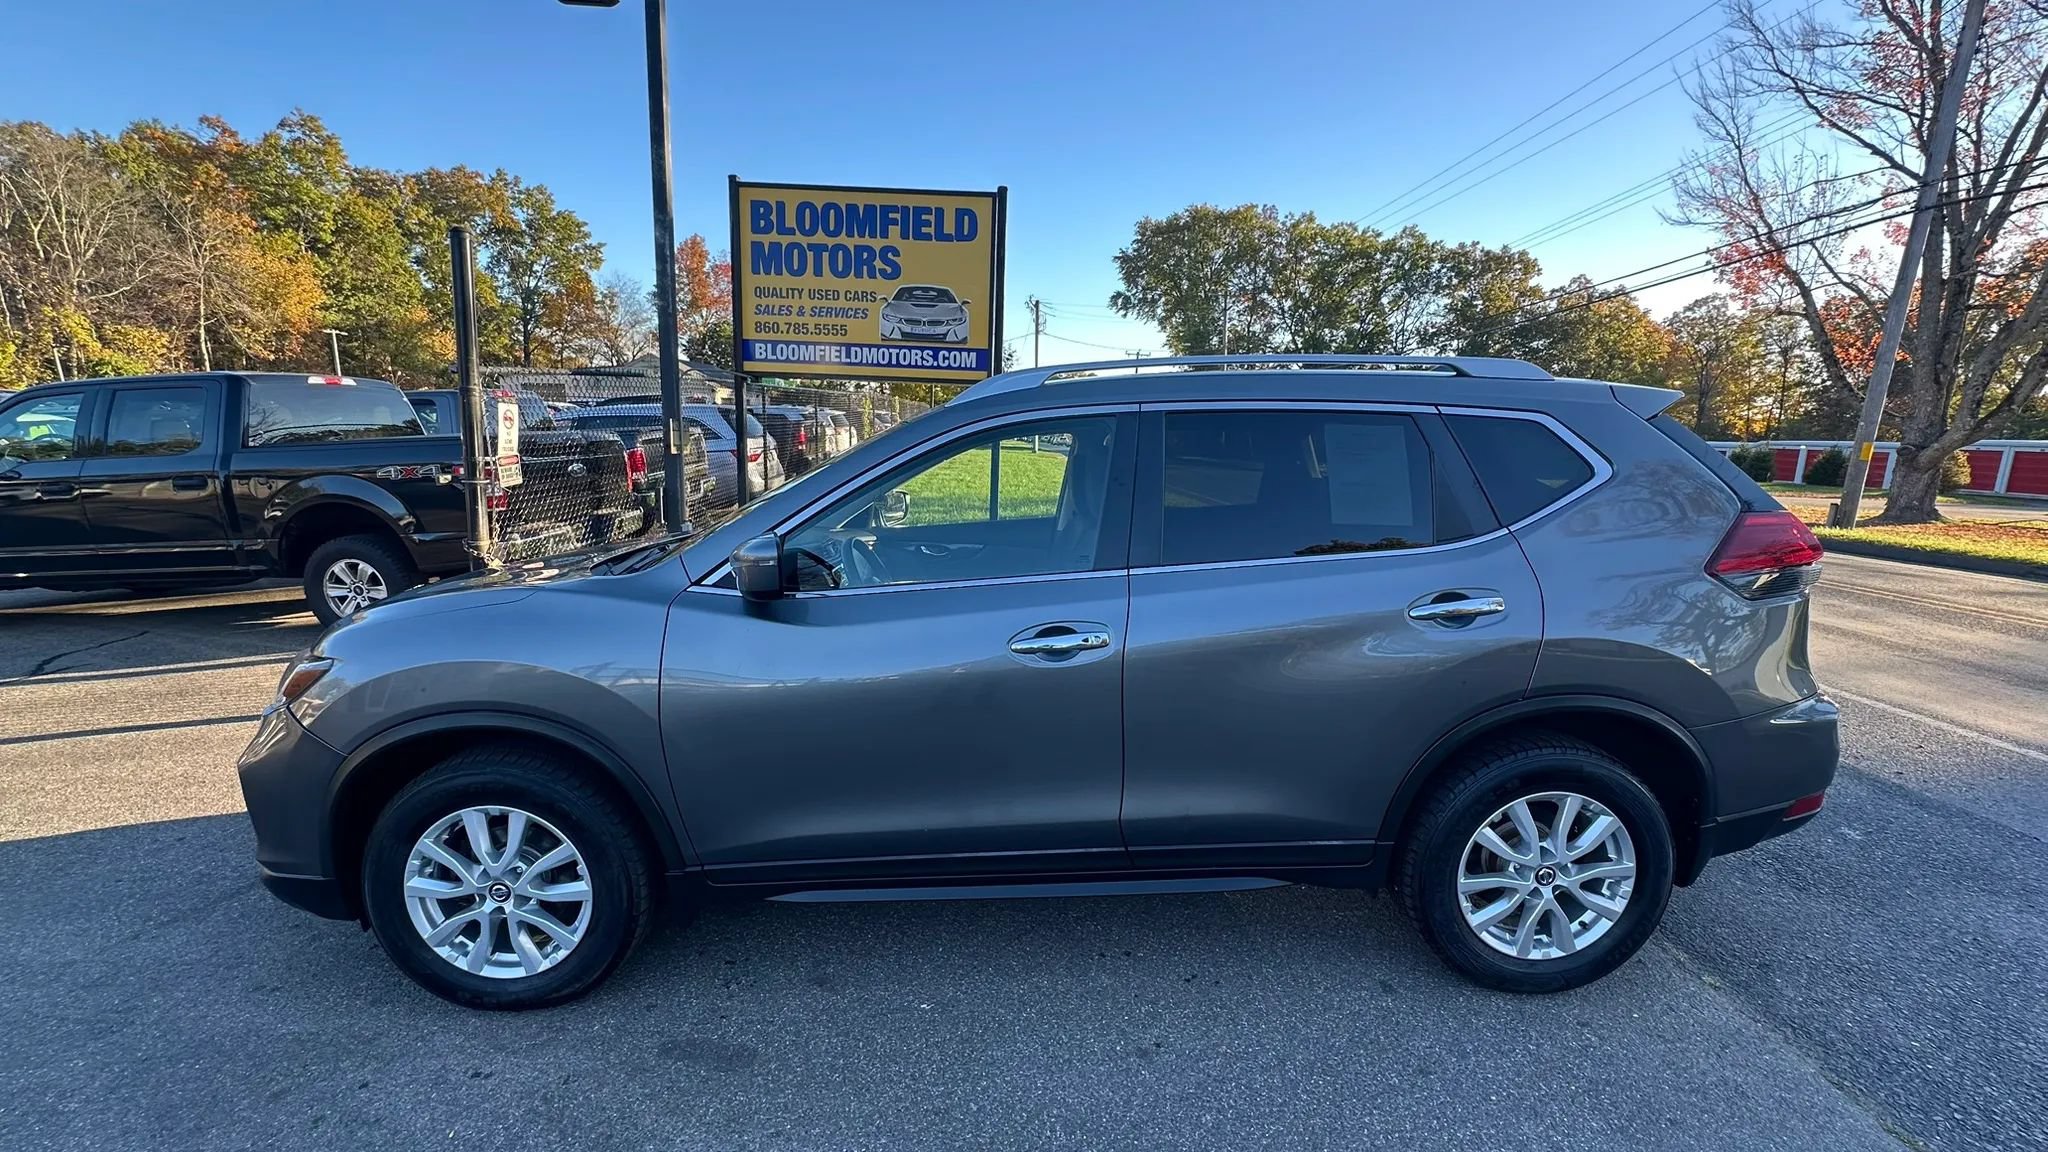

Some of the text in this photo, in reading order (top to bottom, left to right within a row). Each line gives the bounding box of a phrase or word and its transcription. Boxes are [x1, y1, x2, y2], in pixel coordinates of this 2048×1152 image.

[750, 199, 979, 243] BLOOMFIELD
[750, 240, 902, 280] MOTORS
[754, 286, 877, 303] QUALITY USED CARS
[754, 304, 869, 320] SALES & SERVICES
[754, 321, 848, 337] 860.785.5555
[754, 342, 977, 368] BLOOMFIELDMOTORS.COM
